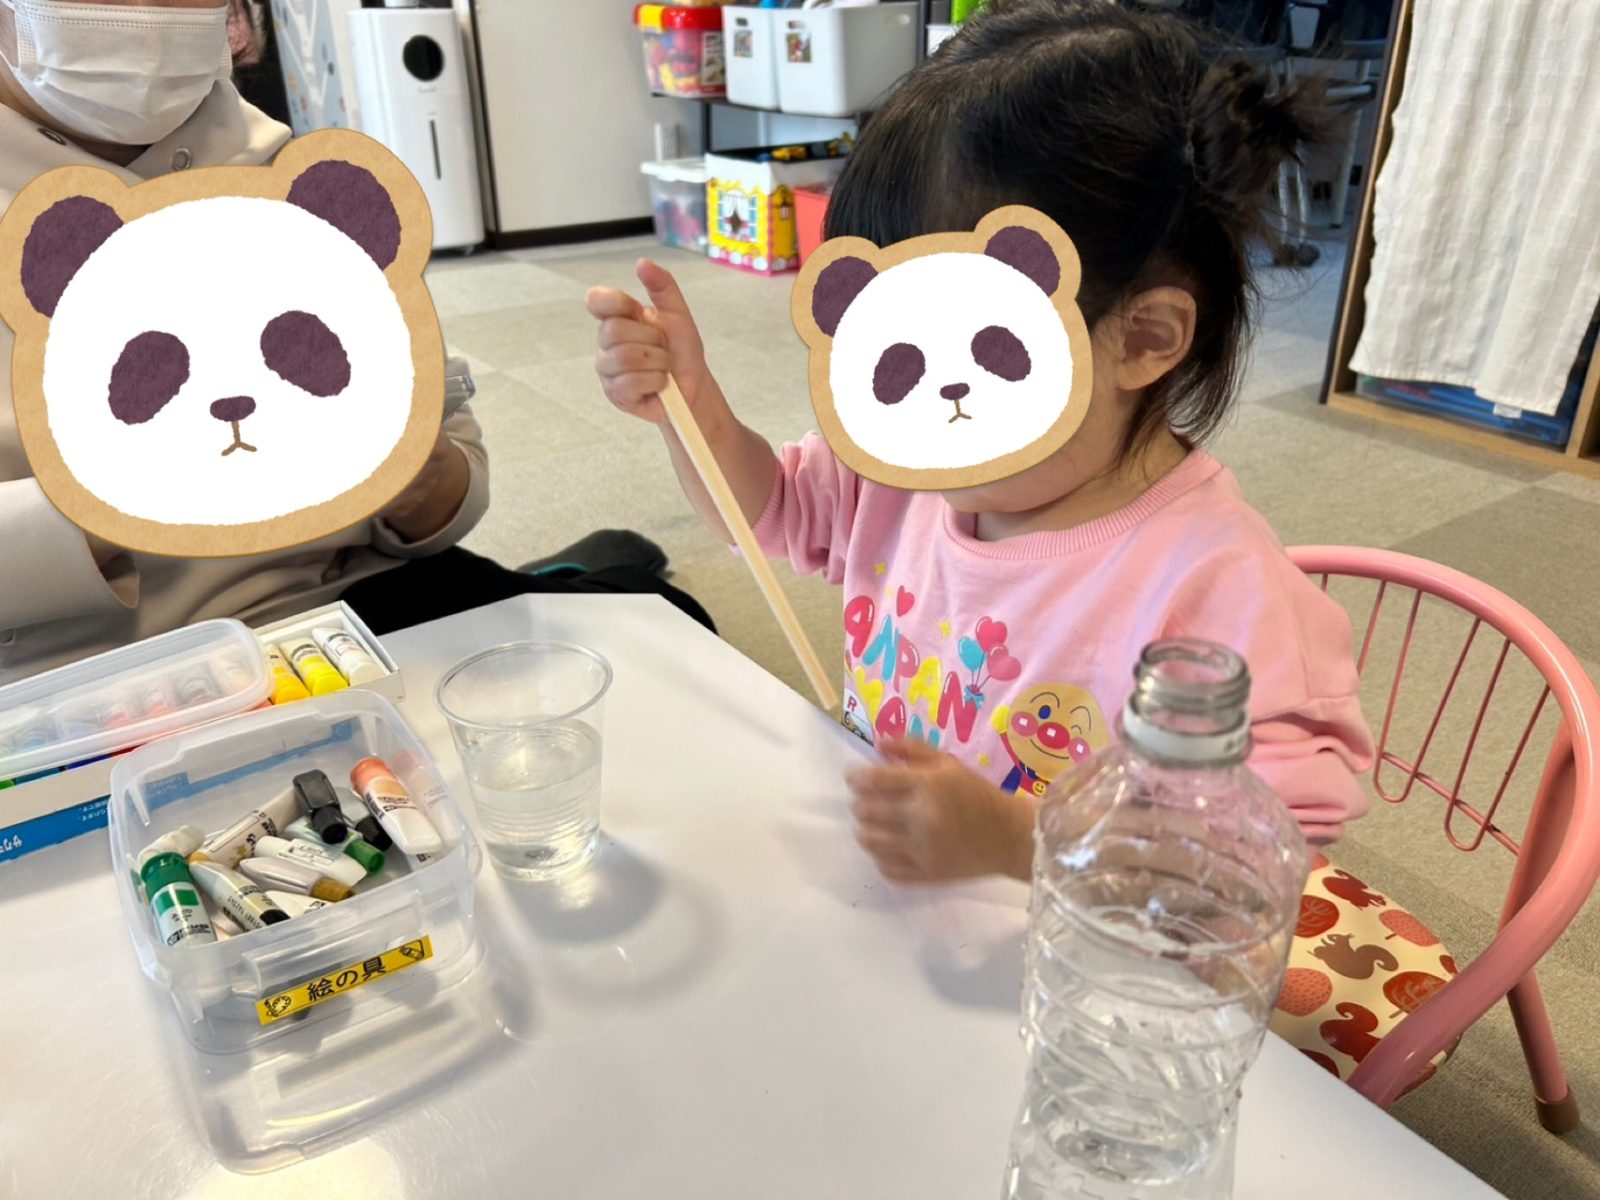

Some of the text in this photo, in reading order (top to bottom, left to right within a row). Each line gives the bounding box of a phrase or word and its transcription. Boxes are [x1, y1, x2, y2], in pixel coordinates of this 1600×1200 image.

[844, 595, 978, 744] ANPAN
[307, 956, 386, 1002] 絵の具
